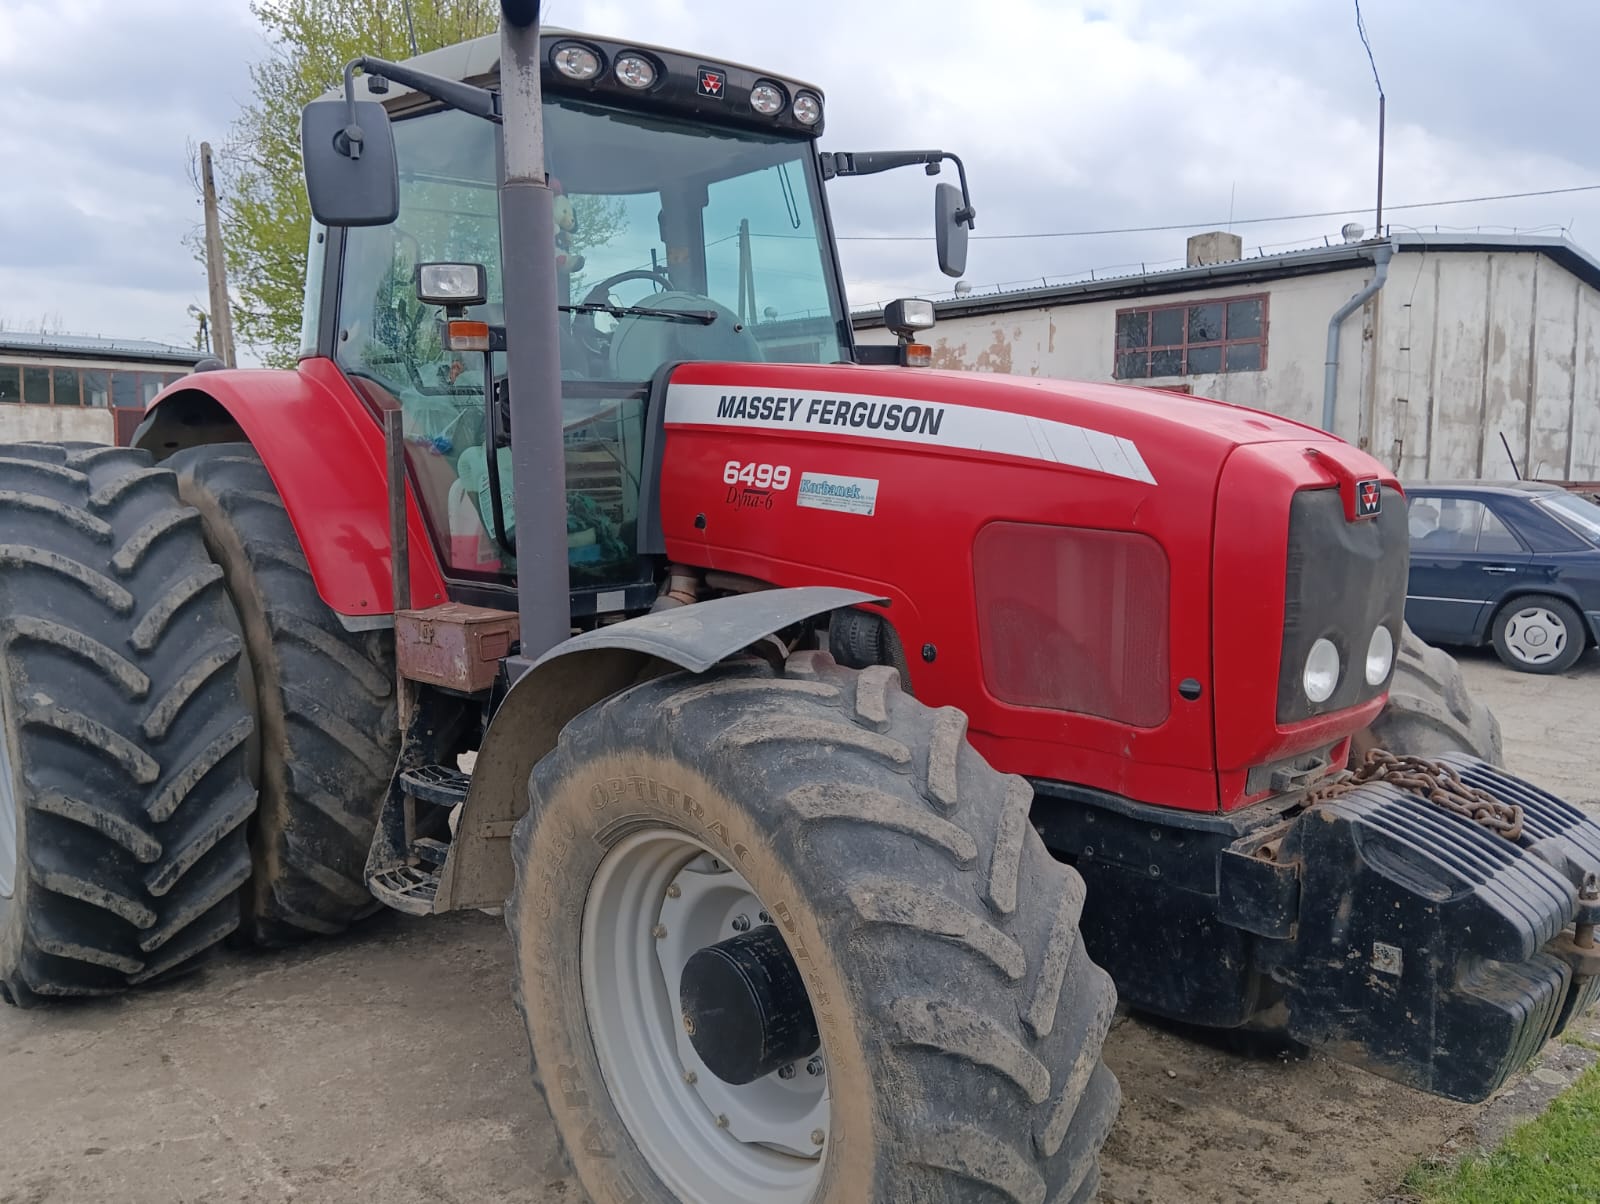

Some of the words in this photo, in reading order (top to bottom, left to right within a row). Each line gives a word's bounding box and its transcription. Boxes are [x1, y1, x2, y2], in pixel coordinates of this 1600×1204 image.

[717, 396, 803, 421] MASSEY
[806, 399, 945, 435] FERGUSON
[723, 460, 792, 490] 6499
[800, 479, 861, 499] Korbanek
[726, 486, 776, 511] Dyna-6
[591, 776, 758, 873] OPTITRAC
